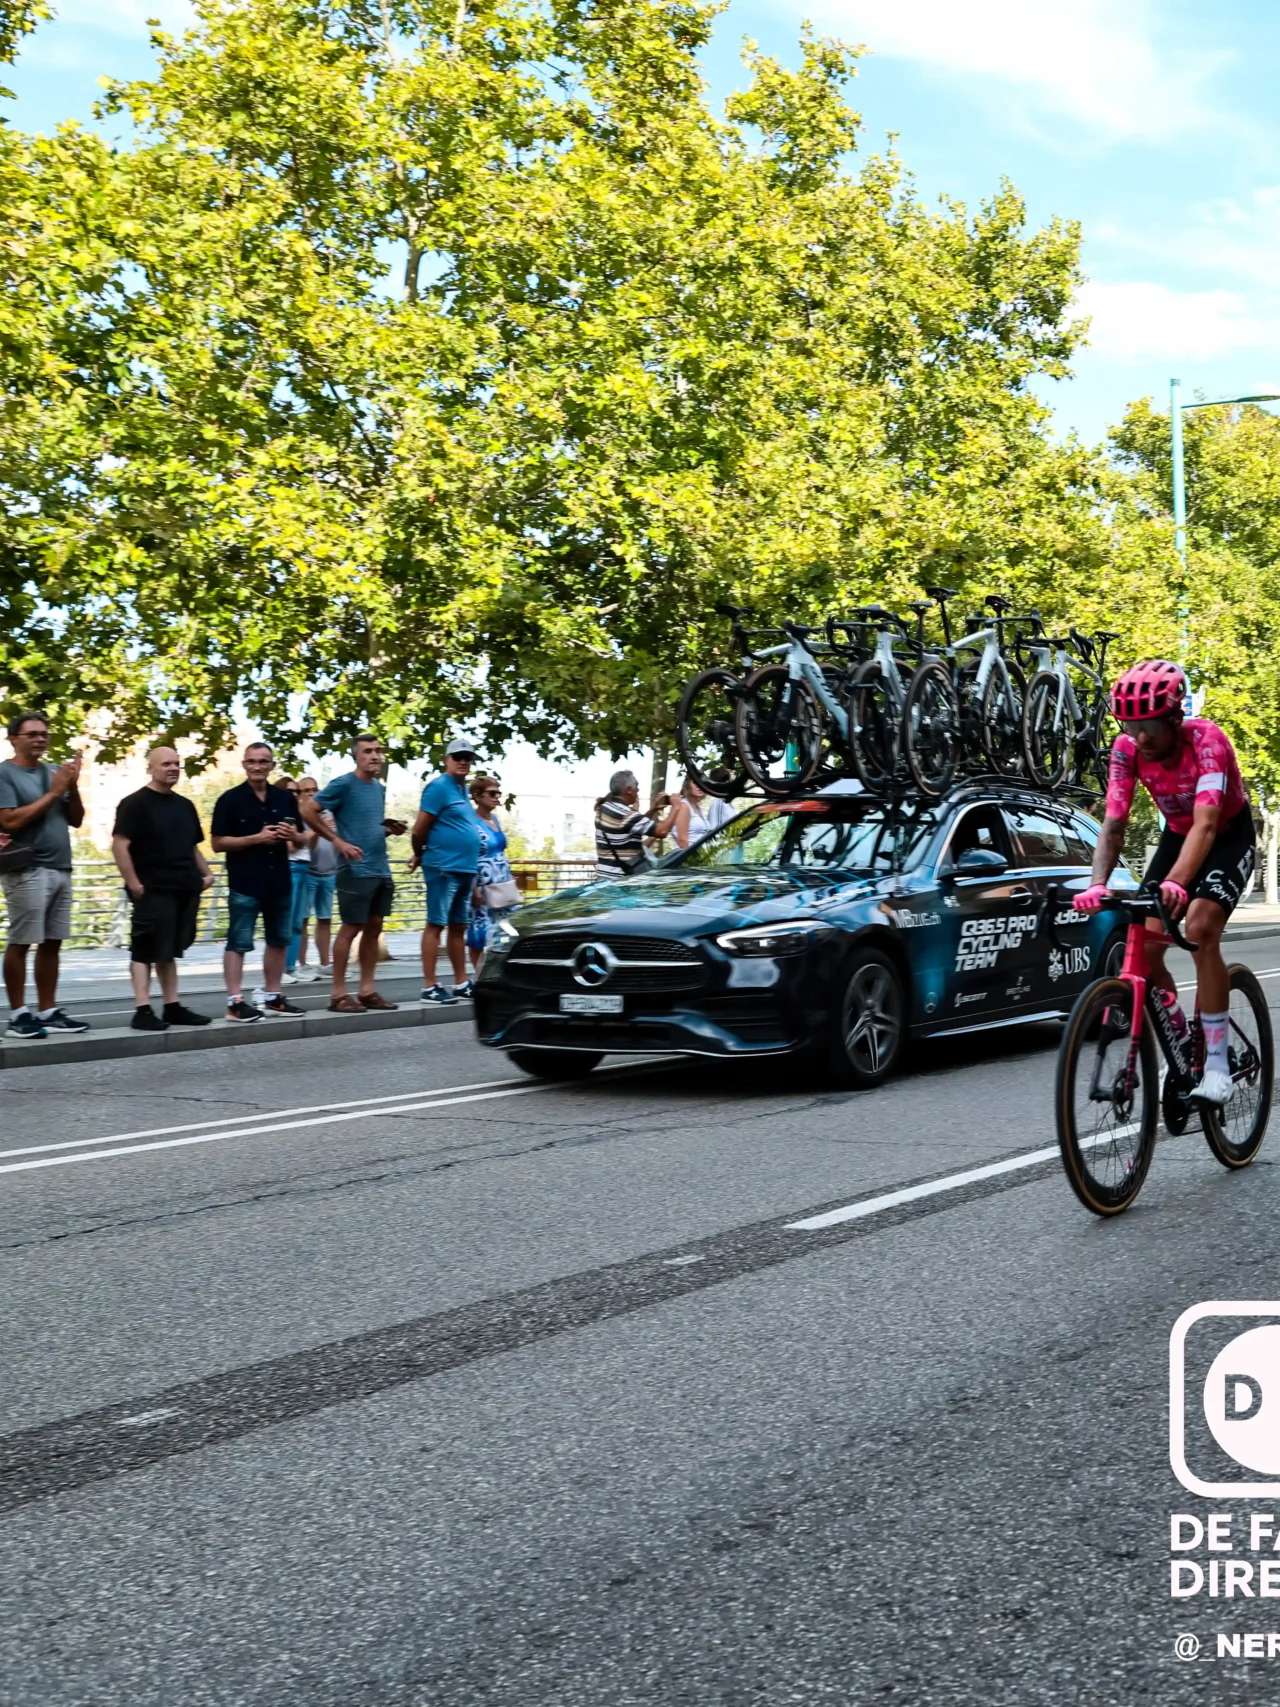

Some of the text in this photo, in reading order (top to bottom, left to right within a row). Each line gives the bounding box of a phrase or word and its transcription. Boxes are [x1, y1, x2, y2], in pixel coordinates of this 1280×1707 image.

[1007, 914, 1037, 933] PRO
[957, 932, 1023, 955] CYCLING
[955, 950, 999, 973] TEAM
[1065, 945, 1091, 975] UBS
